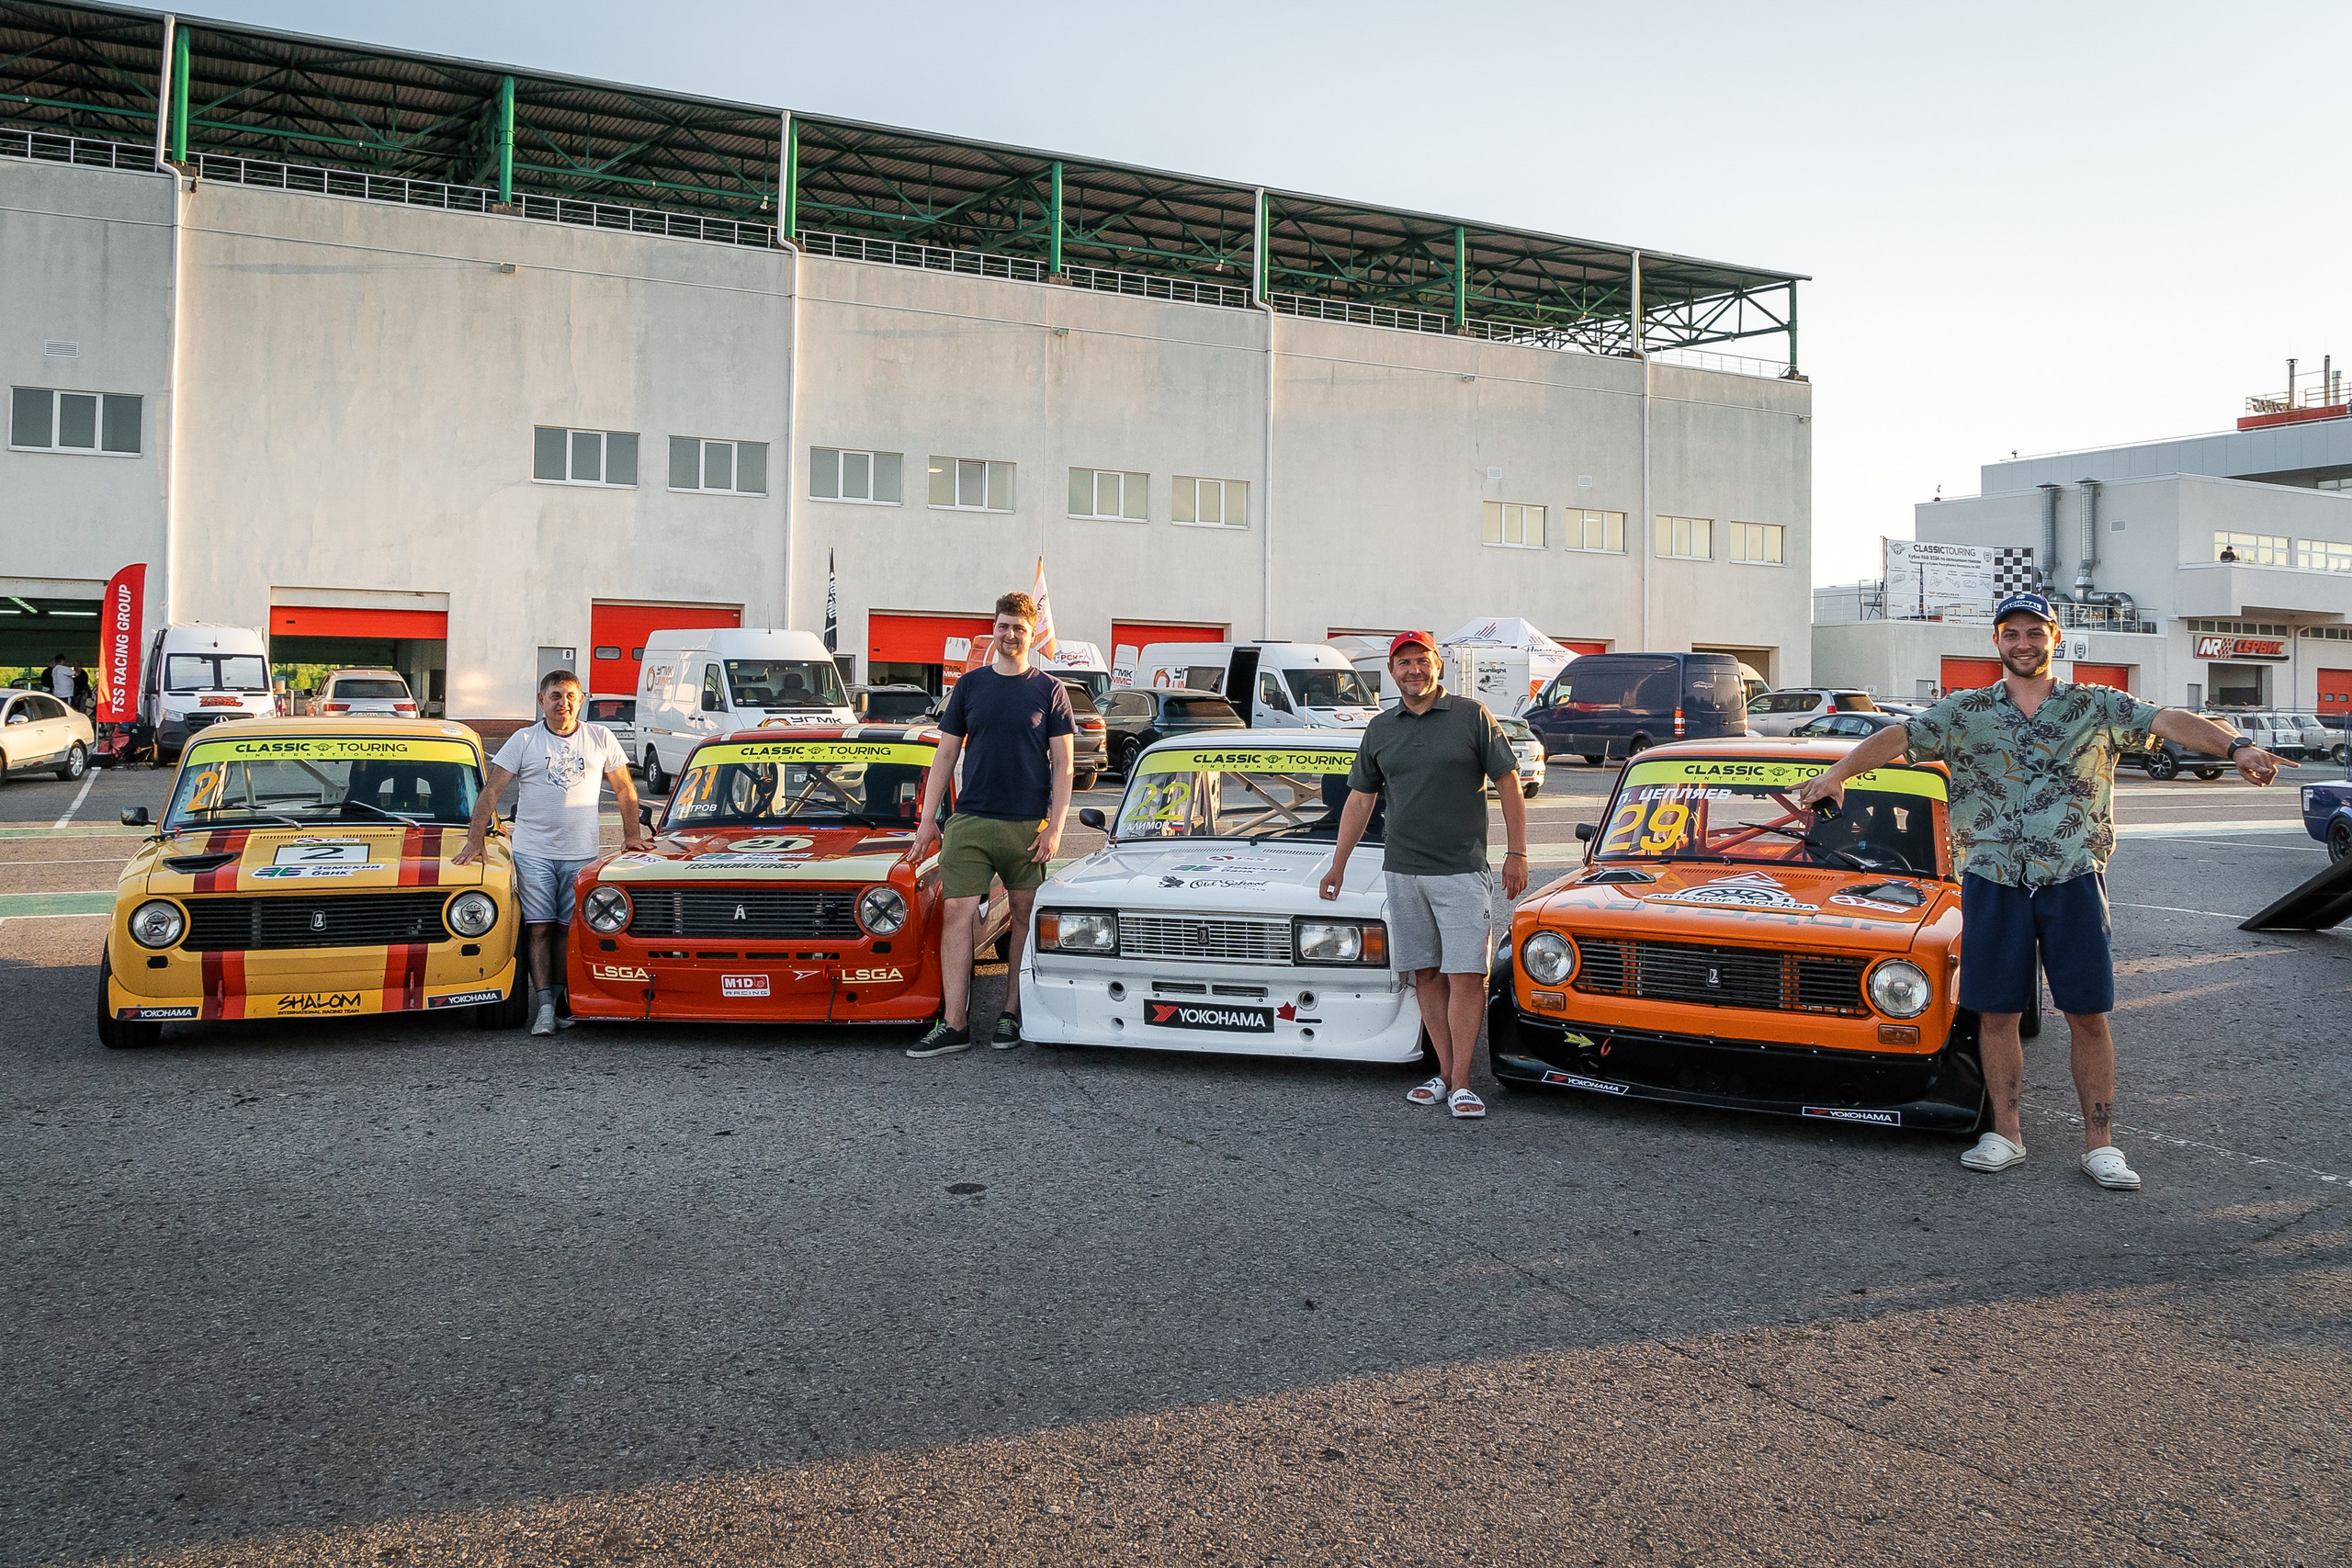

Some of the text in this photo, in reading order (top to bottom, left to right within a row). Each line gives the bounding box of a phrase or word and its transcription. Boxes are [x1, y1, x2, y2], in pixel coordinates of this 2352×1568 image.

[1913, 544, 1976, 557] CLASSICTOURING
[112, 583, 131, 714] TSS RACING GROUP
[2234, 639, 2286, 655] СЕРВИС
[565, 650, 571, 659] 8
[1113, 668, 1133, 678] ГМК
[1478, 667, 1507, 676] Sunlight
[1111, 676, 1132, 686] MMC
[790, 716, 842, 724] УГМК
[235, 742, 408, 752] CLASSIC TOURING
[741, 746, 891, 756] CLASSIC TOURING
[545, 756, 585, 771] 7 3
[1193, 753, 1354, 765] CLASSIC TOURING
[1684, 765, 1877, 781] CLASSIC TONG
[185, 771, 218, 811] 2
[677, 764, 718, 805] 21
[1123, 782, 1192, 823] 22
[1617, 788, 1733, 806] П. ЦЕПЛЯЕВ
[1600, 804, 1690, 853] 29
[737, 840, 798, 850] 21
[300, 847, 345, 860] 2
[1189, 879, 1270, 889] Old School
[1652, 894, 1815, 910] АВТОДОР МОСКВА
[593, 964, 650, 979] LSGA
[842, 967, 904, 981] LSGA
[724, 977, 753, 988] M1D
[277, 992, 361, 1011] SHALOM
[448, 992, 498, 1004] YOKOHAMA
[140, 1009, 192, 1018] YOKOHAMA
[1178, 1008, 1266, 1027] YOKOHAMA
[1567, 1077, 1620, 1092] YOKOHAMA
[1829, 1111, 1893, 1122] YOKOHAMA
